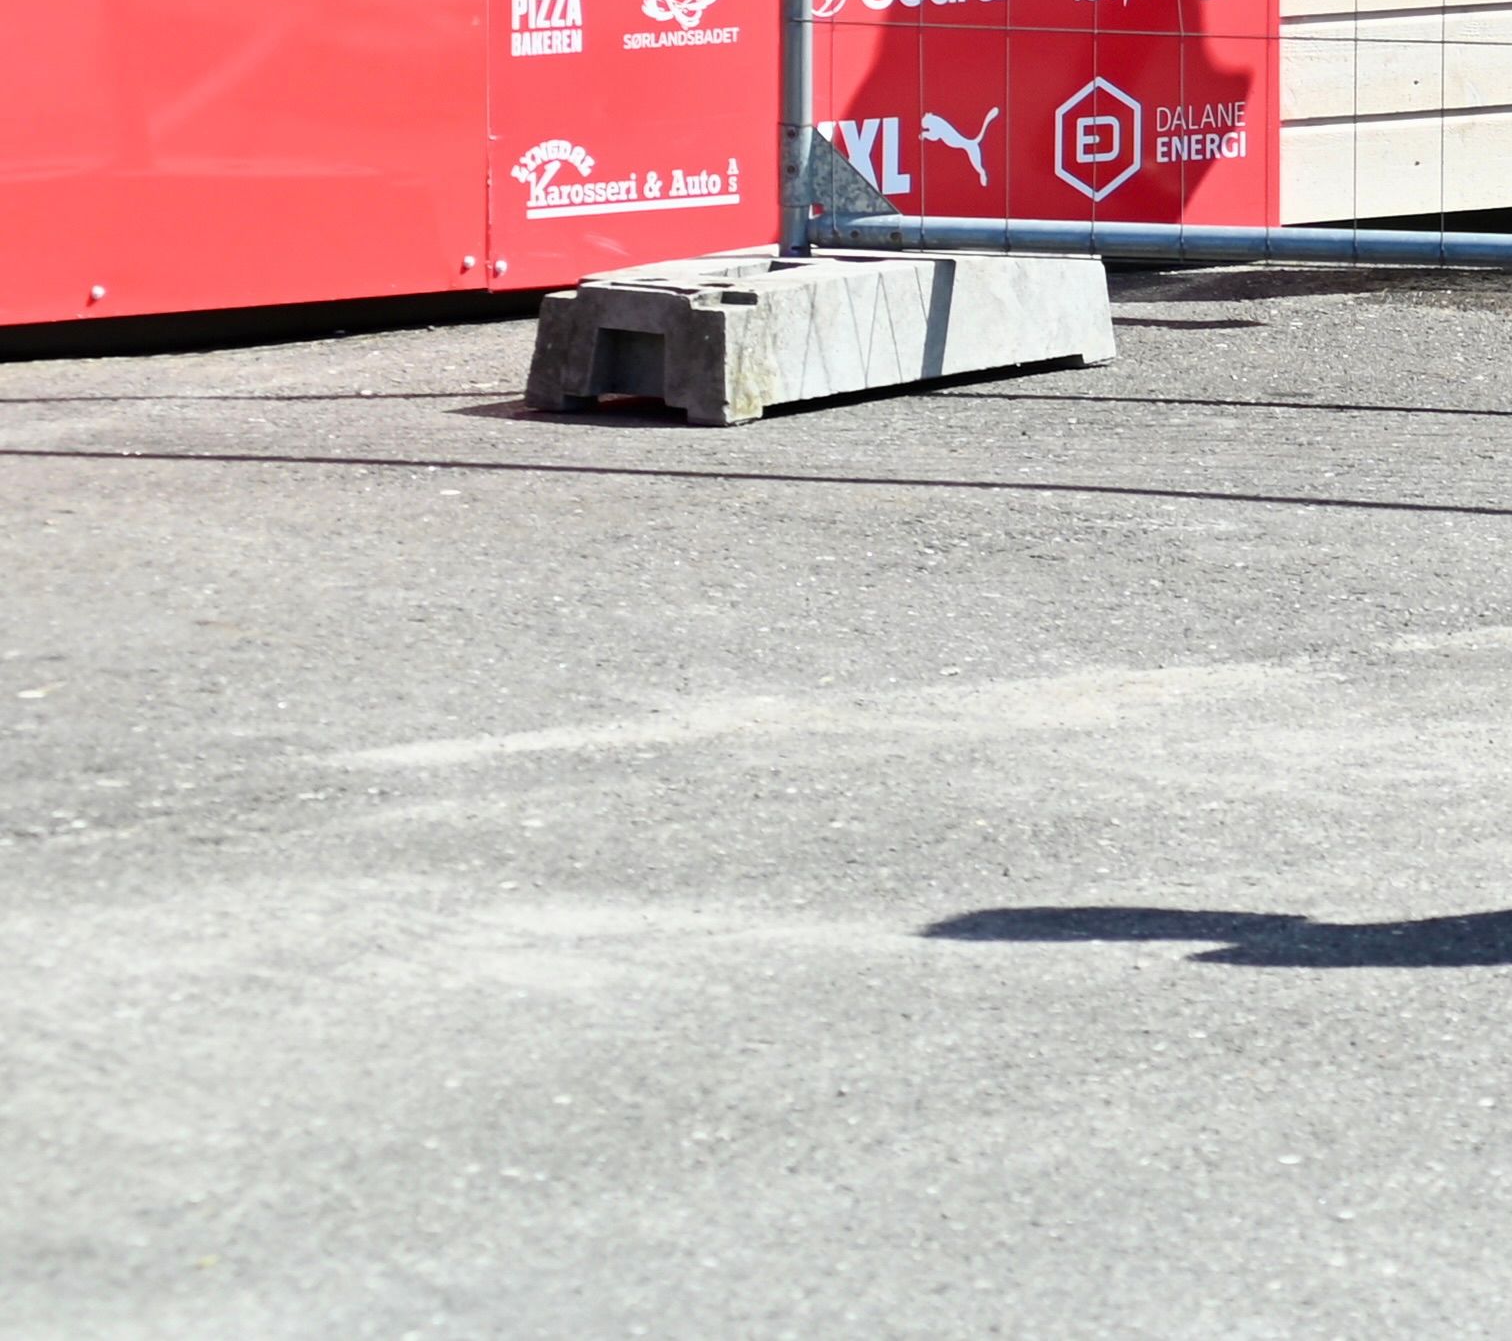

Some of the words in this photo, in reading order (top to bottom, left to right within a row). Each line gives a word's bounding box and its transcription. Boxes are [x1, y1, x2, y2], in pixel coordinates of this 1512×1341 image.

[511, 30, 582, 57] BAKEREN
[623, 28, 739, 49] SØRLANDSBADET
[1156, 101, 1245, 132] DALANE
[1156, 133, 1246, 164] ENERGI
[527, 161, 637, 207] Karosseri
[644, 171, 662, 199] &
[669, 169, 721, 196] Auto
